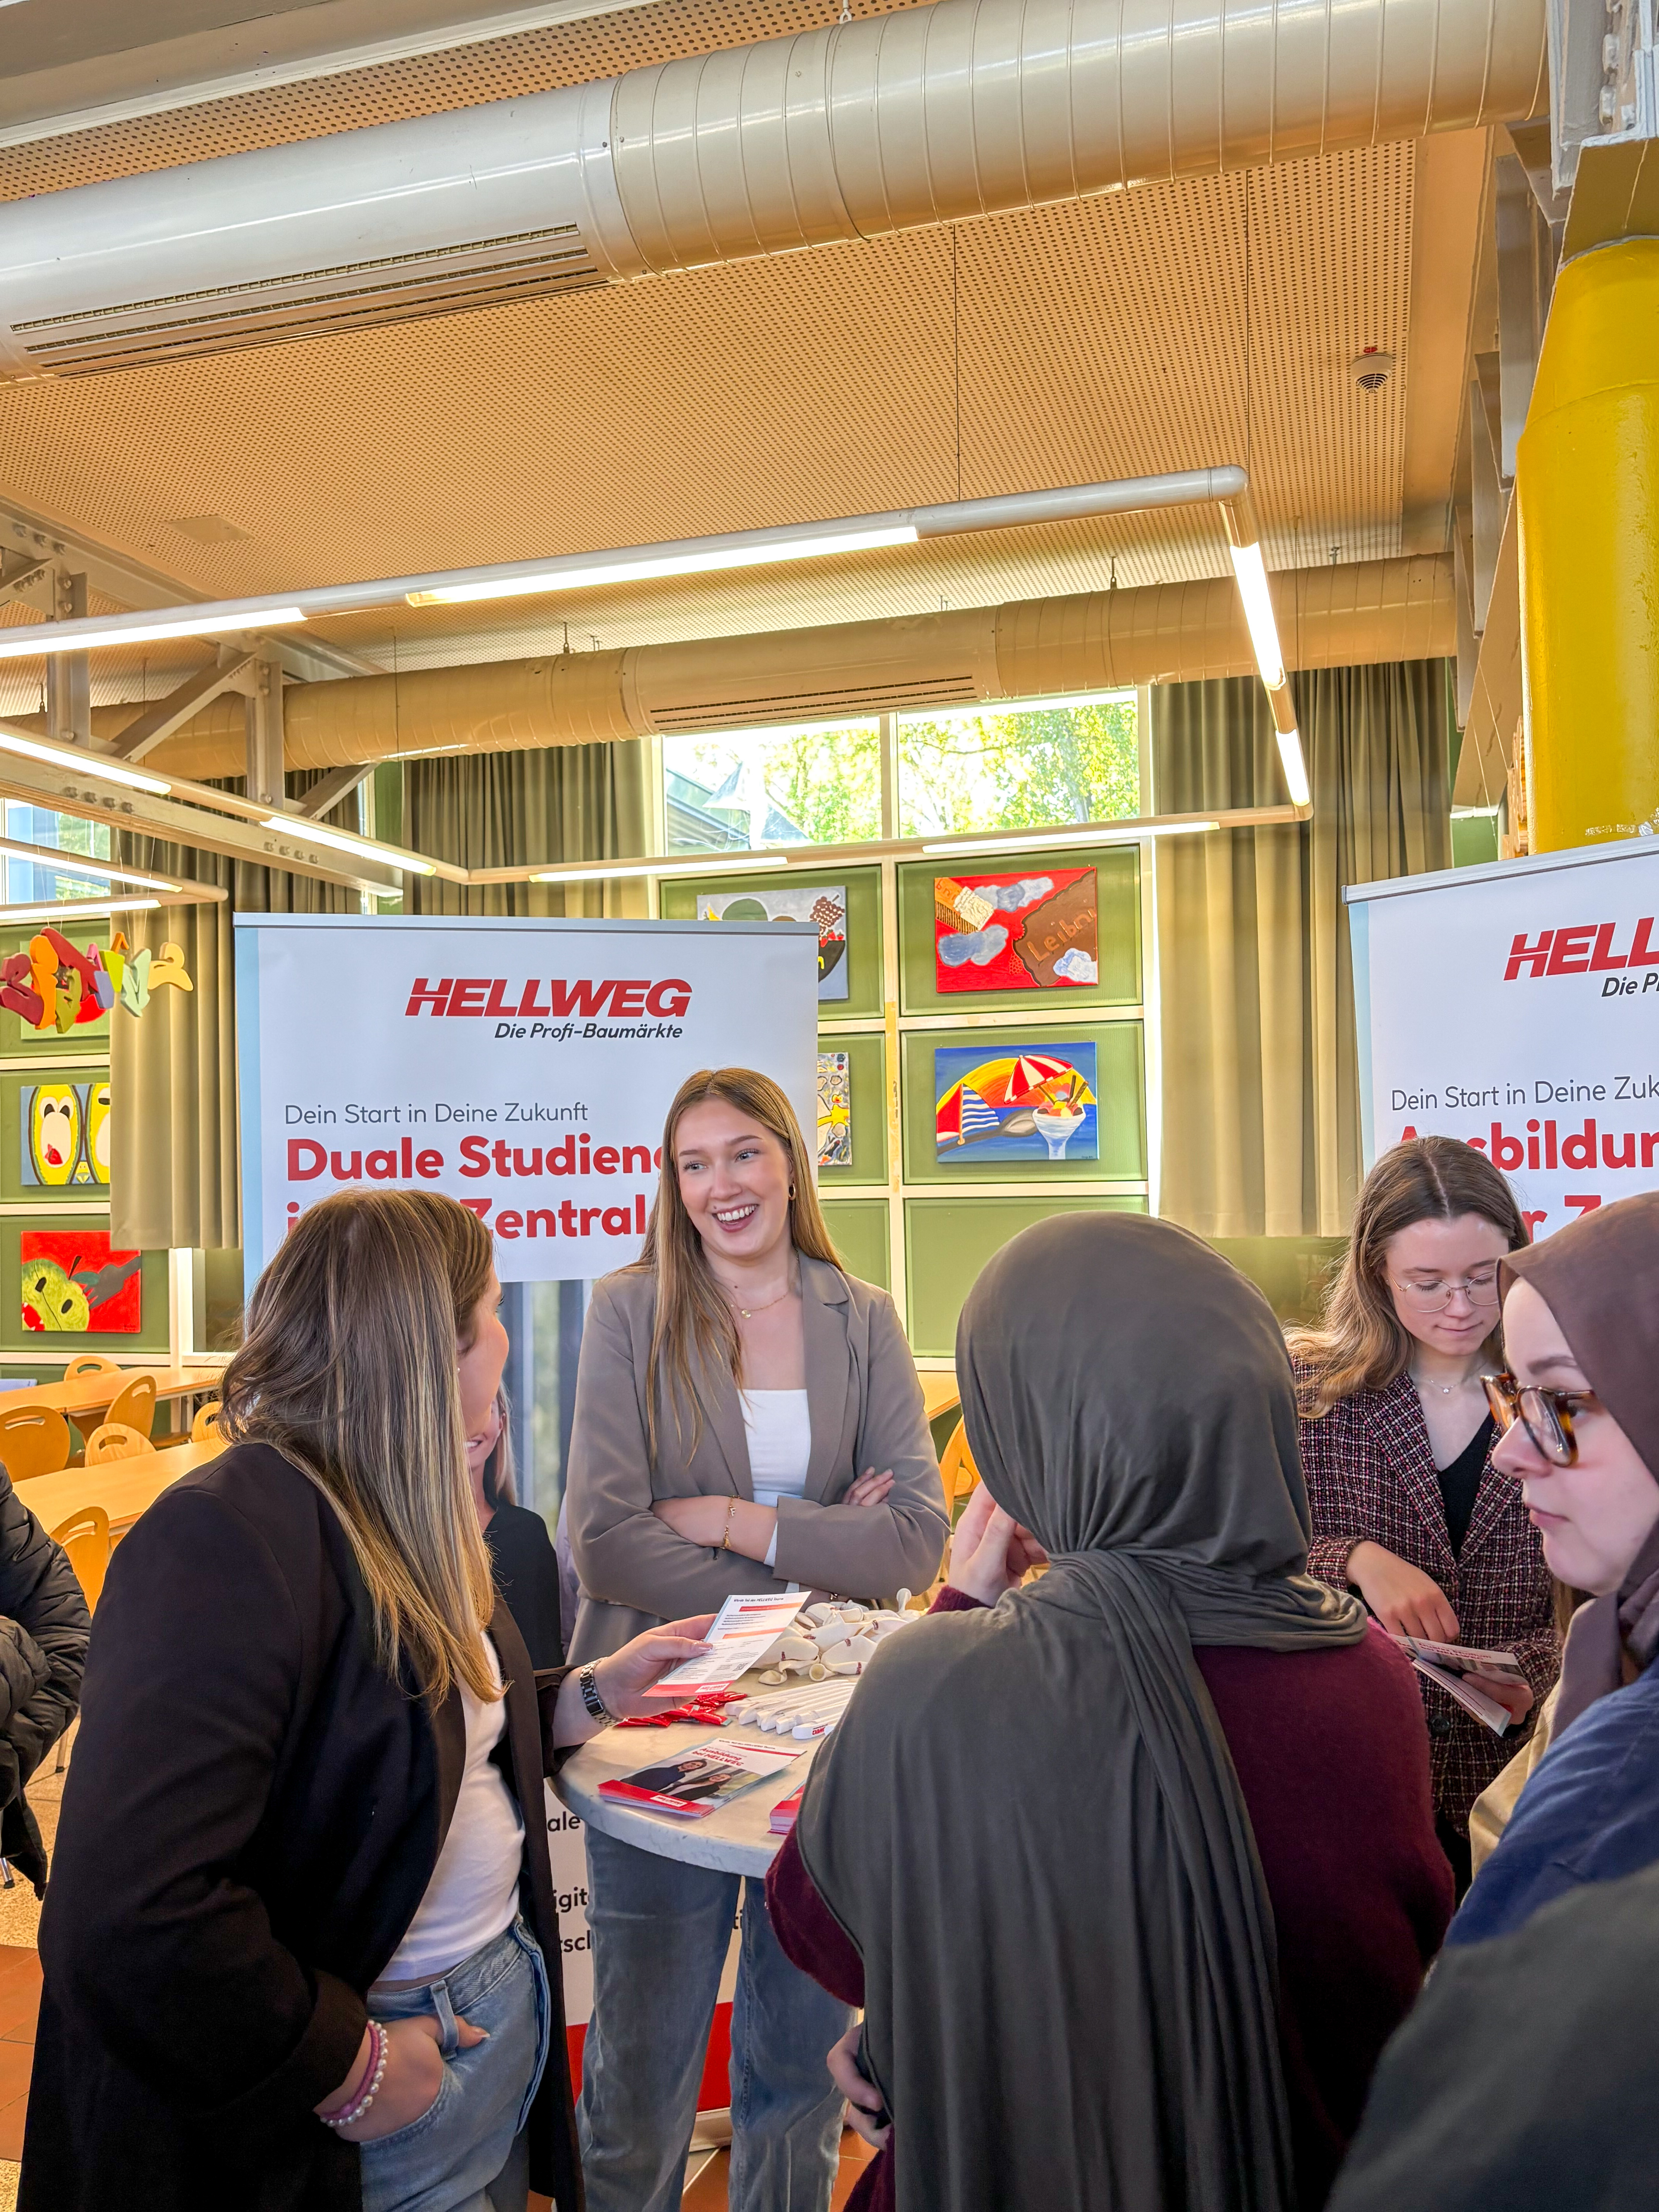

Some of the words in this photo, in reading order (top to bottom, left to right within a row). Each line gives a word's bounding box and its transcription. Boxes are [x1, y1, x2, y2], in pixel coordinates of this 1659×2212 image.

[405, 978, 692, 1017] HELLWEG
[1601, 976, 1638, 997] Die
[1642, 972, 1659, 993] P
[495, 1023, 526, 1038] Die
[530, 1023, 683, 1042] Profi-Baumärkte
[1392, 1088, 1437, 1111] Dein
[1445, 1086, 1499, 1108] Start
[1506, 1083, 1526, 1104] in
[1535, 1079, 1606, 1104] Deine
[285, 1104, 336, 1124] Dein
[345, 1104, 401, 1123] Start
[408, 1103, 426, 1123] in
[435, 1103, 498, 1122] Deine
[504, 1102, 588, 1121] Zukunft
[287, 1137, 444, 1181] Duale
[458, 1132, 663, 1177] Studien
